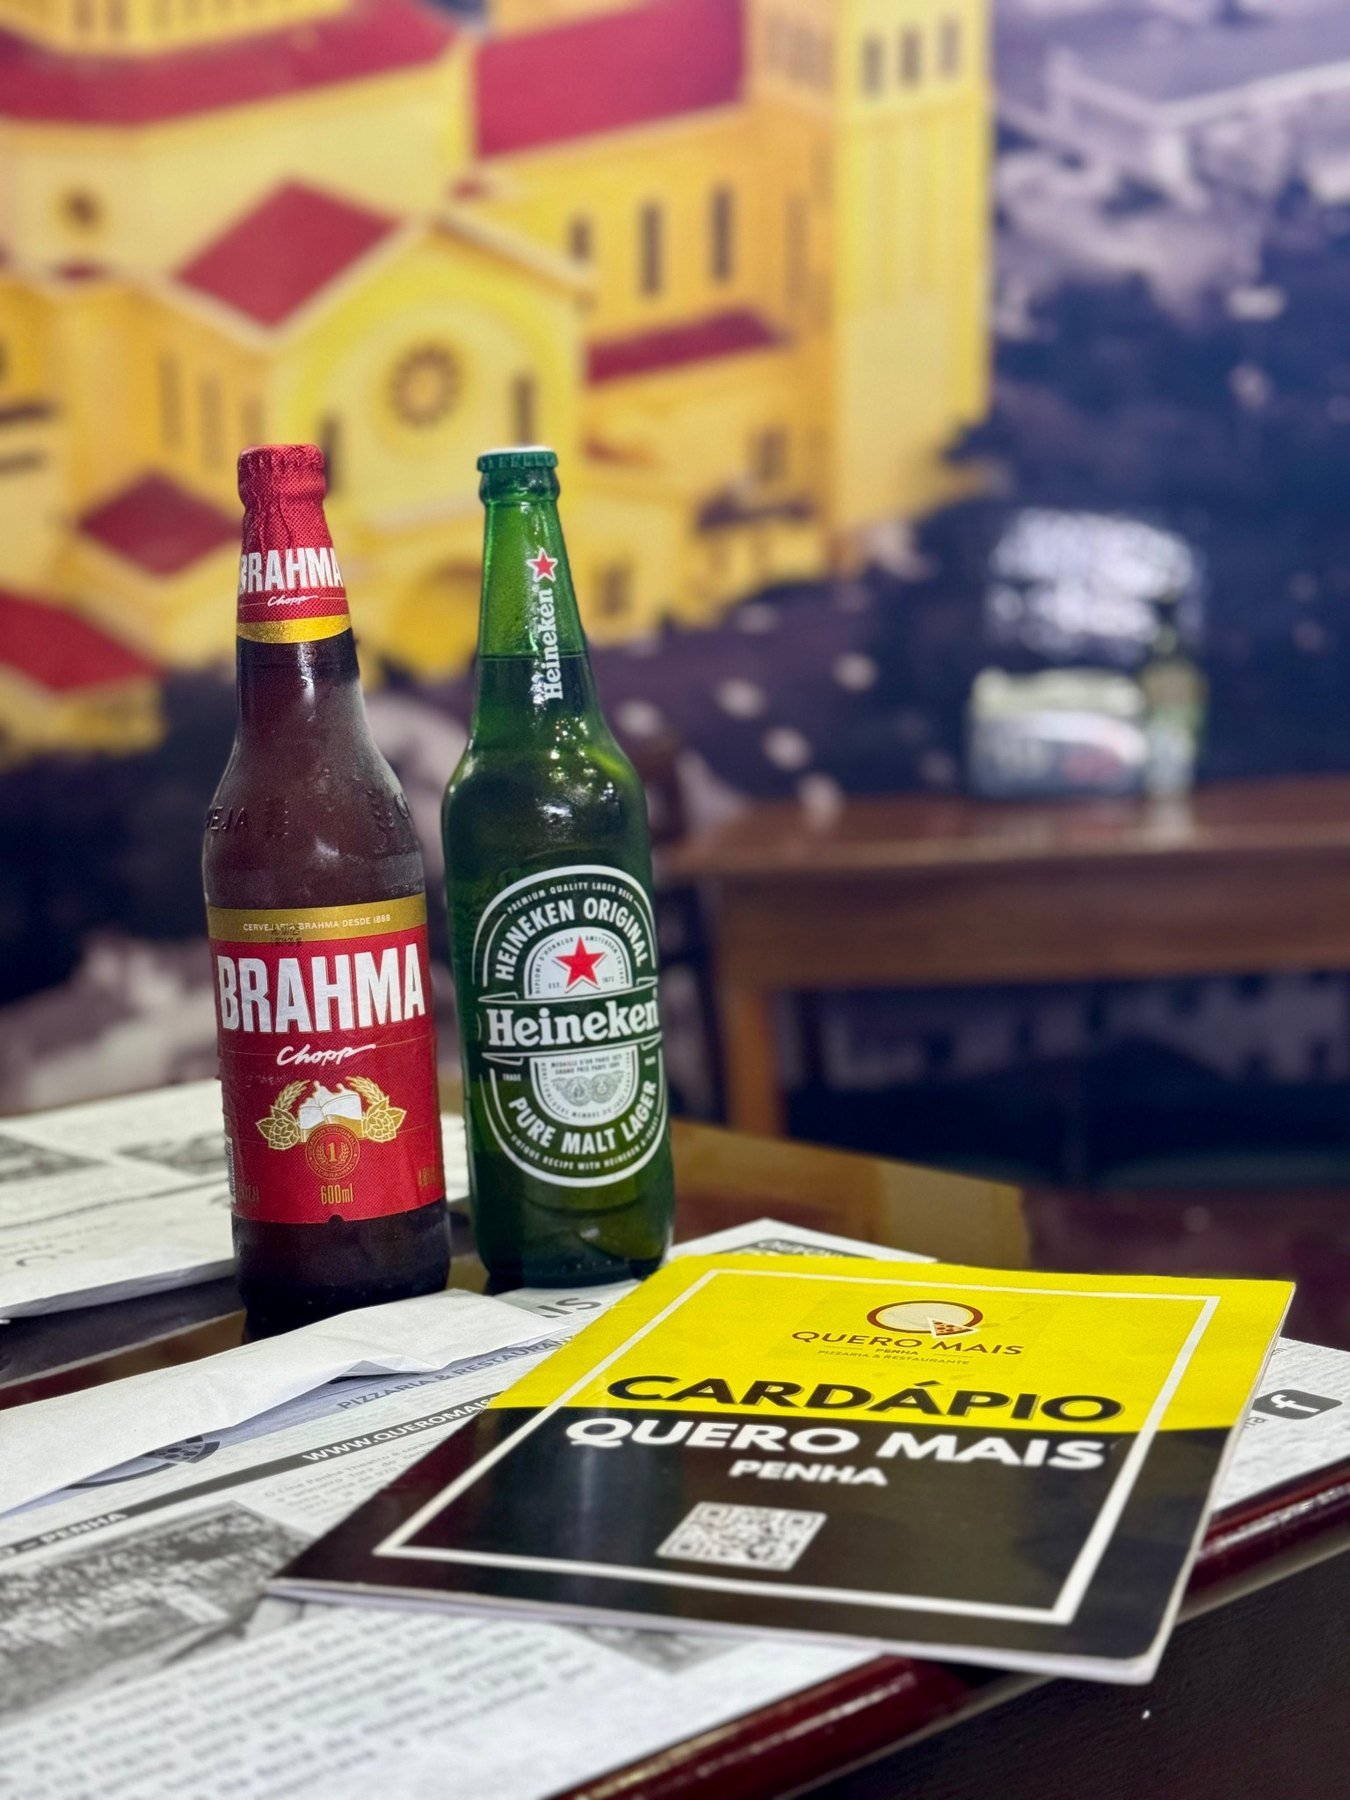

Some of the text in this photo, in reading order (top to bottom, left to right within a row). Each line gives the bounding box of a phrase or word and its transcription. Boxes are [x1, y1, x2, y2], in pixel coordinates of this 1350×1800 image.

[267, 594, 320, 607] Chopp
[538, 587, 564, 700] Heineken
[507, 889, 547, 914] PREMIUM
[550, 881, 589, 895] QUALITY
[591, 882, 617, 893] LAGER
[299, 921, 339, 931] BRAHMA
[342, 917, 371, 928] DESDE
[373, 914, 391, 924] 1888
[495, 896, 649, 982] HEINEKEN ORIGINAL
[217, 943, 426, 1033] BRAHMA
[486, 1000, 660, 1047] Heineken
[276, 1043, 377, 1067] Chopp
[508, 1080, 657, 1155] PURE MALT LAGER
[327, 1141, 338, 1163] 1
[542, 1155, 574, 1170] RECIPE
[577, 1161, 601, 1171] WITH
[320, 1183, 354, 1205] 600ml
[792, 1330, 1025, 1356] QUERO MAIS
[817, 1349, 870, 1359] PIZZARIA
[883, 1354, 971, 1366] RESTAURANTE
[875, 1348, 919, 1356] PENHA
[337, 1379, 433, 1411] PIZZARIA
[607, 1375, 1125, 1423] CARDÁPIO
[565, 1416, 1106, 1471] QUERO MAIS
[728, 1459, 889, 1488] PENHA
[41, 1512, 129, 1544] PENHA
